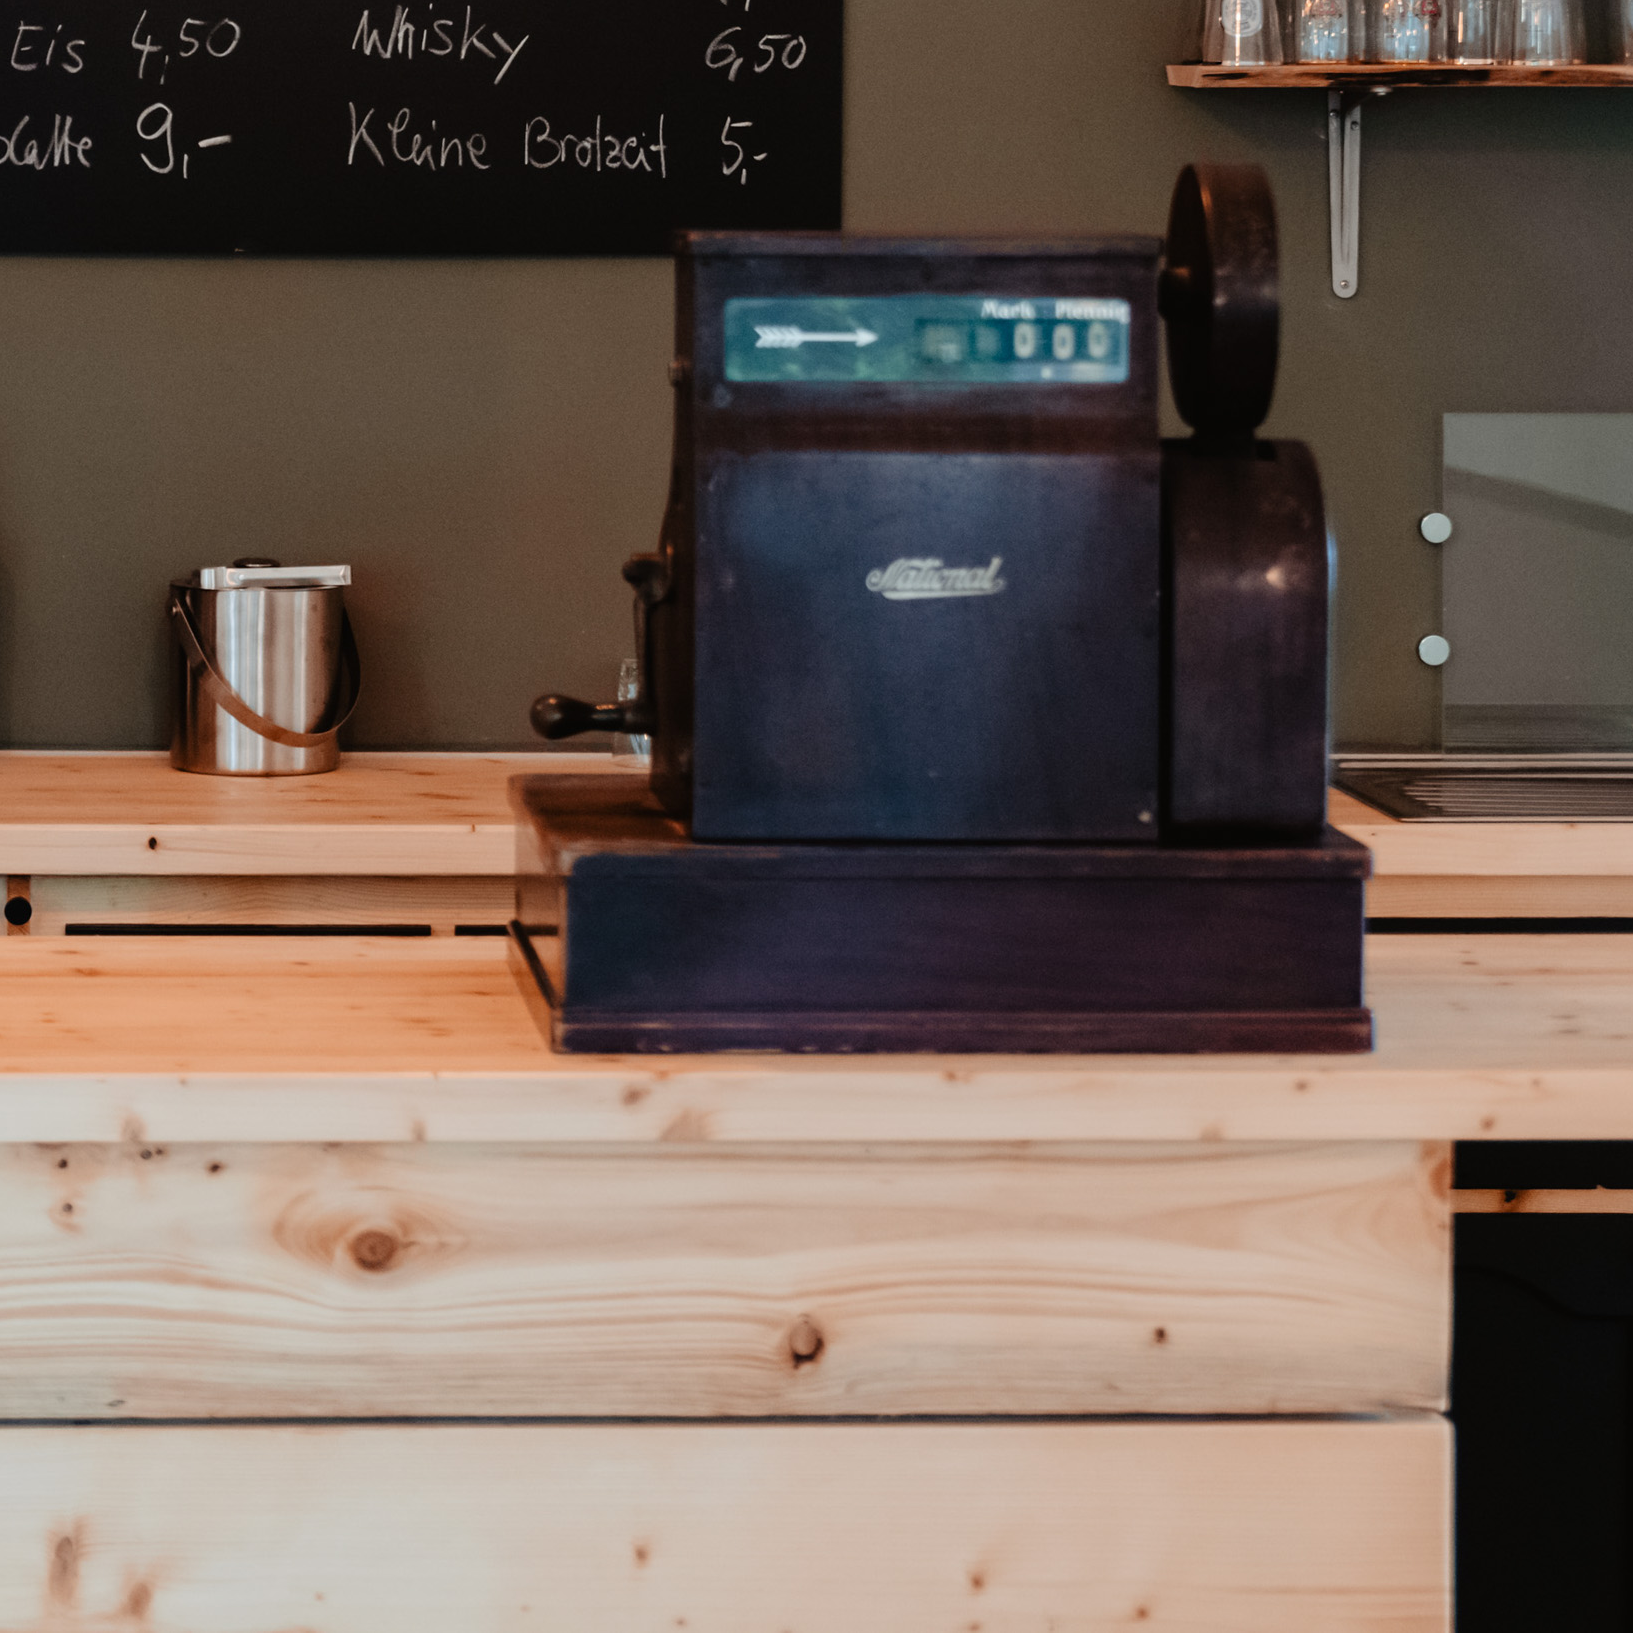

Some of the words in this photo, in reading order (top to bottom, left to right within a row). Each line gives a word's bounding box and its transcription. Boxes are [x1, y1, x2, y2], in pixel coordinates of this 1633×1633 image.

[11, 21, 85, 73] Eis
[132, 10, 240, 84] 4,50
[352, 3, 529, 84] Whisky
[706, 30, 806, 81] 6,50
[348, 102, 489, 170] Kleine
[525, 114, 666, 178] Brotzeit
[865, 555, 1007, 601] National
